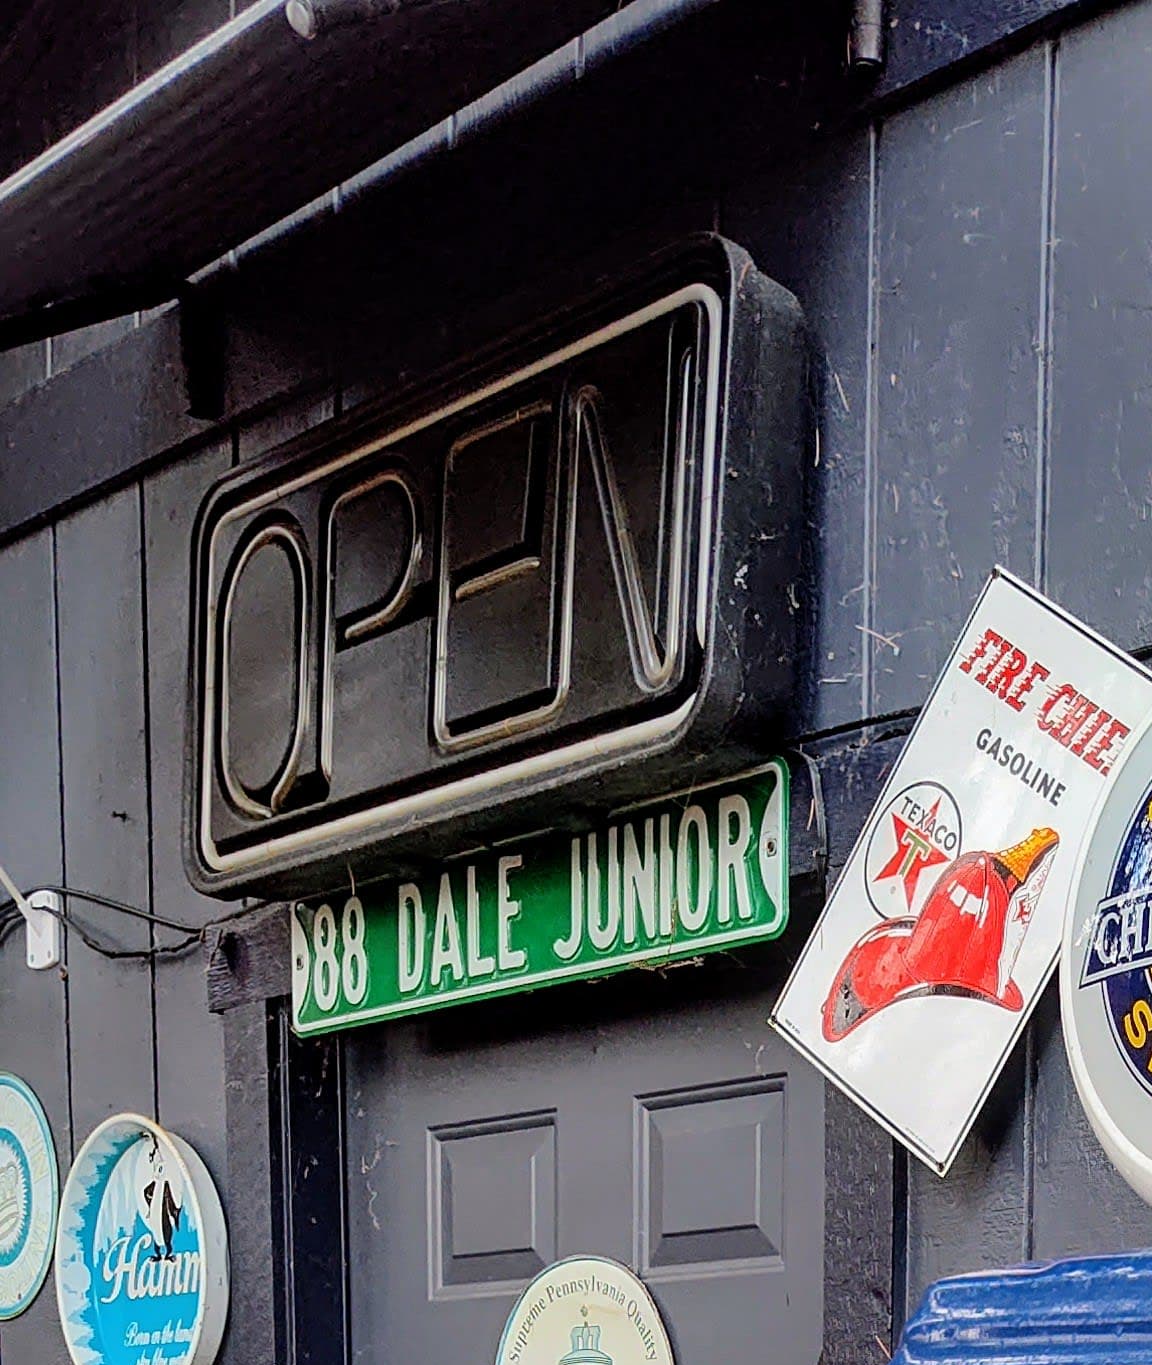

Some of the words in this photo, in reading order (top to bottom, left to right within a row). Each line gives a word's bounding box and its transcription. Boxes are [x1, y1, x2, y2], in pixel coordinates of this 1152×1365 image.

[222, 345, 693, 818] OPEN
[959, 628, 1050, 713] FIRE
[1034, 681, 1131, 777] CHIE
[900, 796, 957, 852] TEXACO
[975, 728, 1067, 808] GASOLINE
[313, 896, 367, 1011] 88
[398, 855, 526, 993] DALE
[553, 793, 752, 959] JUNIOR
[509, 1296, 547, 1365] Supreme
[545, 1275, 627, 1305] Pennsylvania
[627, 1299, 658, 1361] Quality
